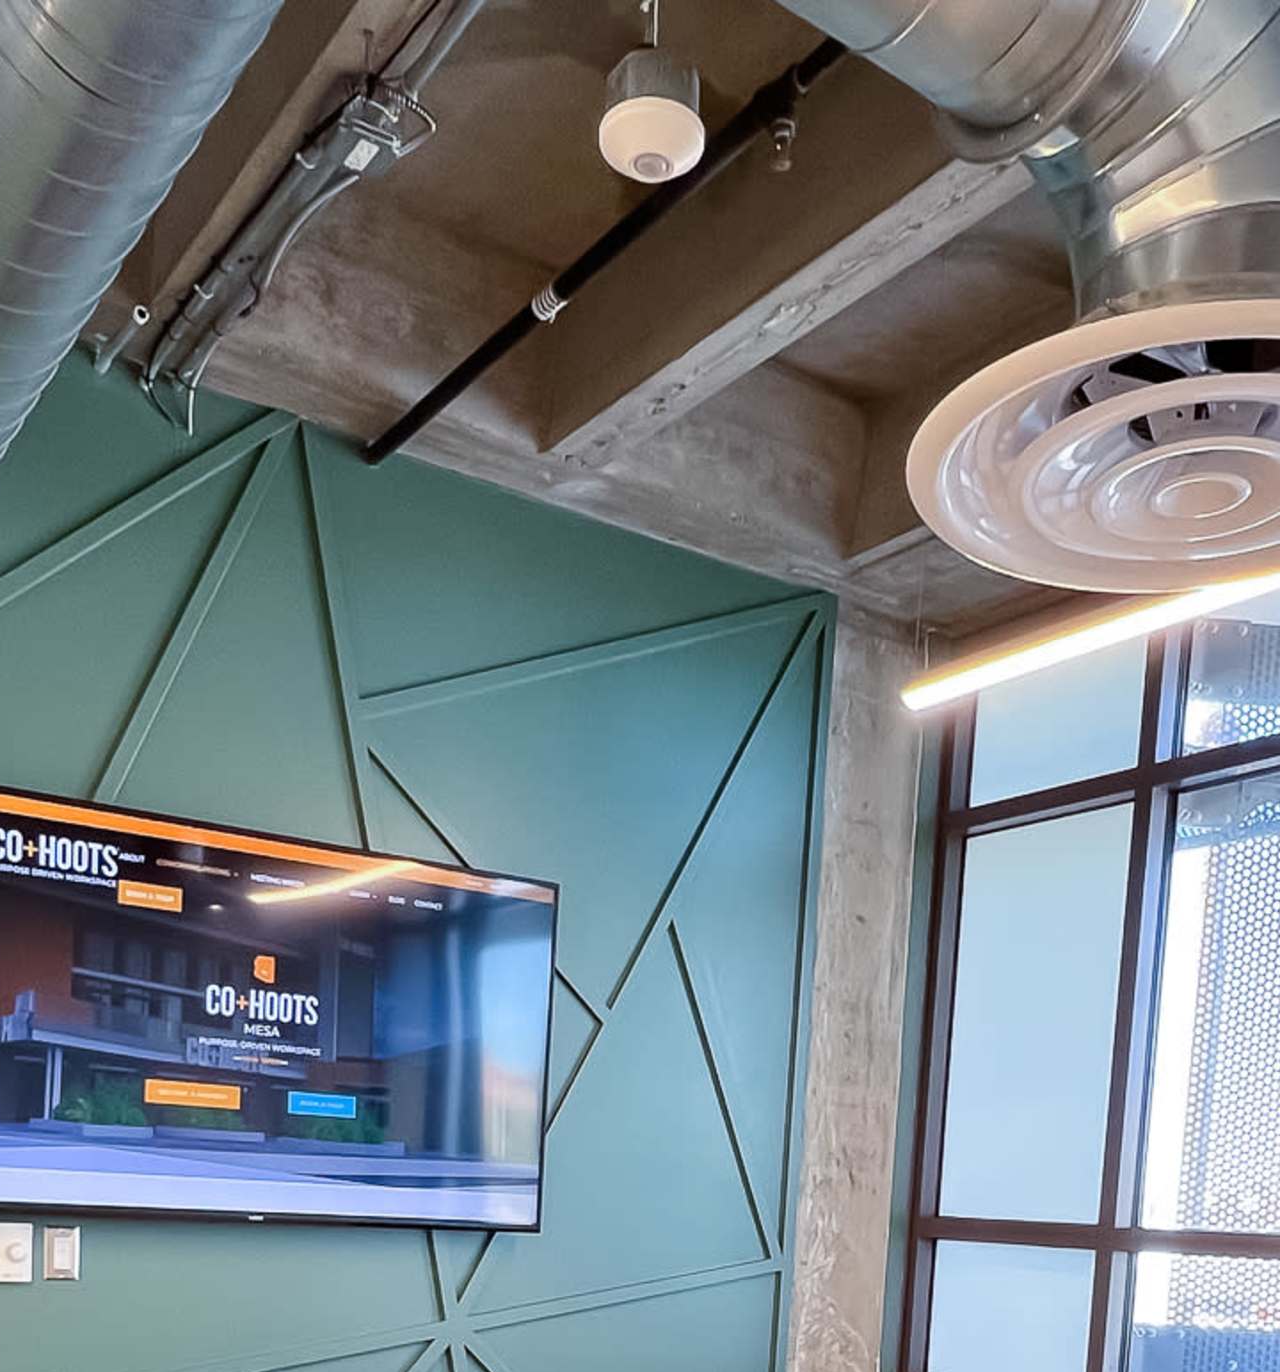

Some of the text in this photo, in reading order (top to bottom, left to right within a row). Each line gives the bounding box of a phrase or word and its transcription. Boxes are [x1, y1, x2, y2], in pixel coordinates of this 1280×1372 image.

[32, 867, 64, 880] DRIVEN
[65, 873, 117, 889] WORKSPACE
[205, 984, 319, 1026] CO+HOOTS
[243, 1023, 281, 1038] MESA
